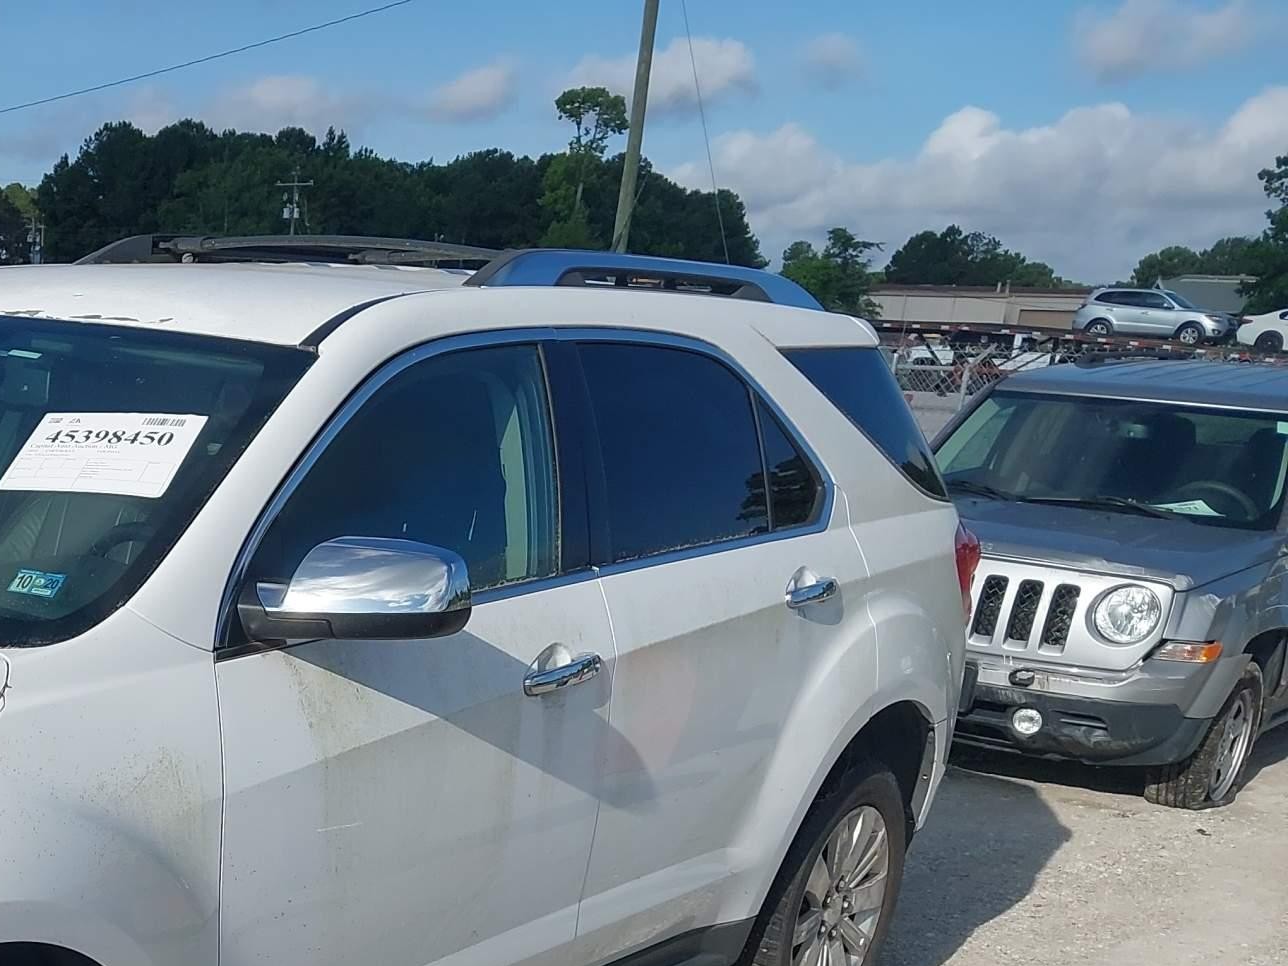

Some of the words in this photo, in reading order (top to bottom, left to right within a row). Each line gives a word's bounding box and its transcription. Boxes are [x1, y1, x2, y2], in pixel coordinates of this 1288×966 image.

[45, 429, 174, 446] 45398450
[16, 574, 33, 589] 10
[44, 578, 60, 589] 20
